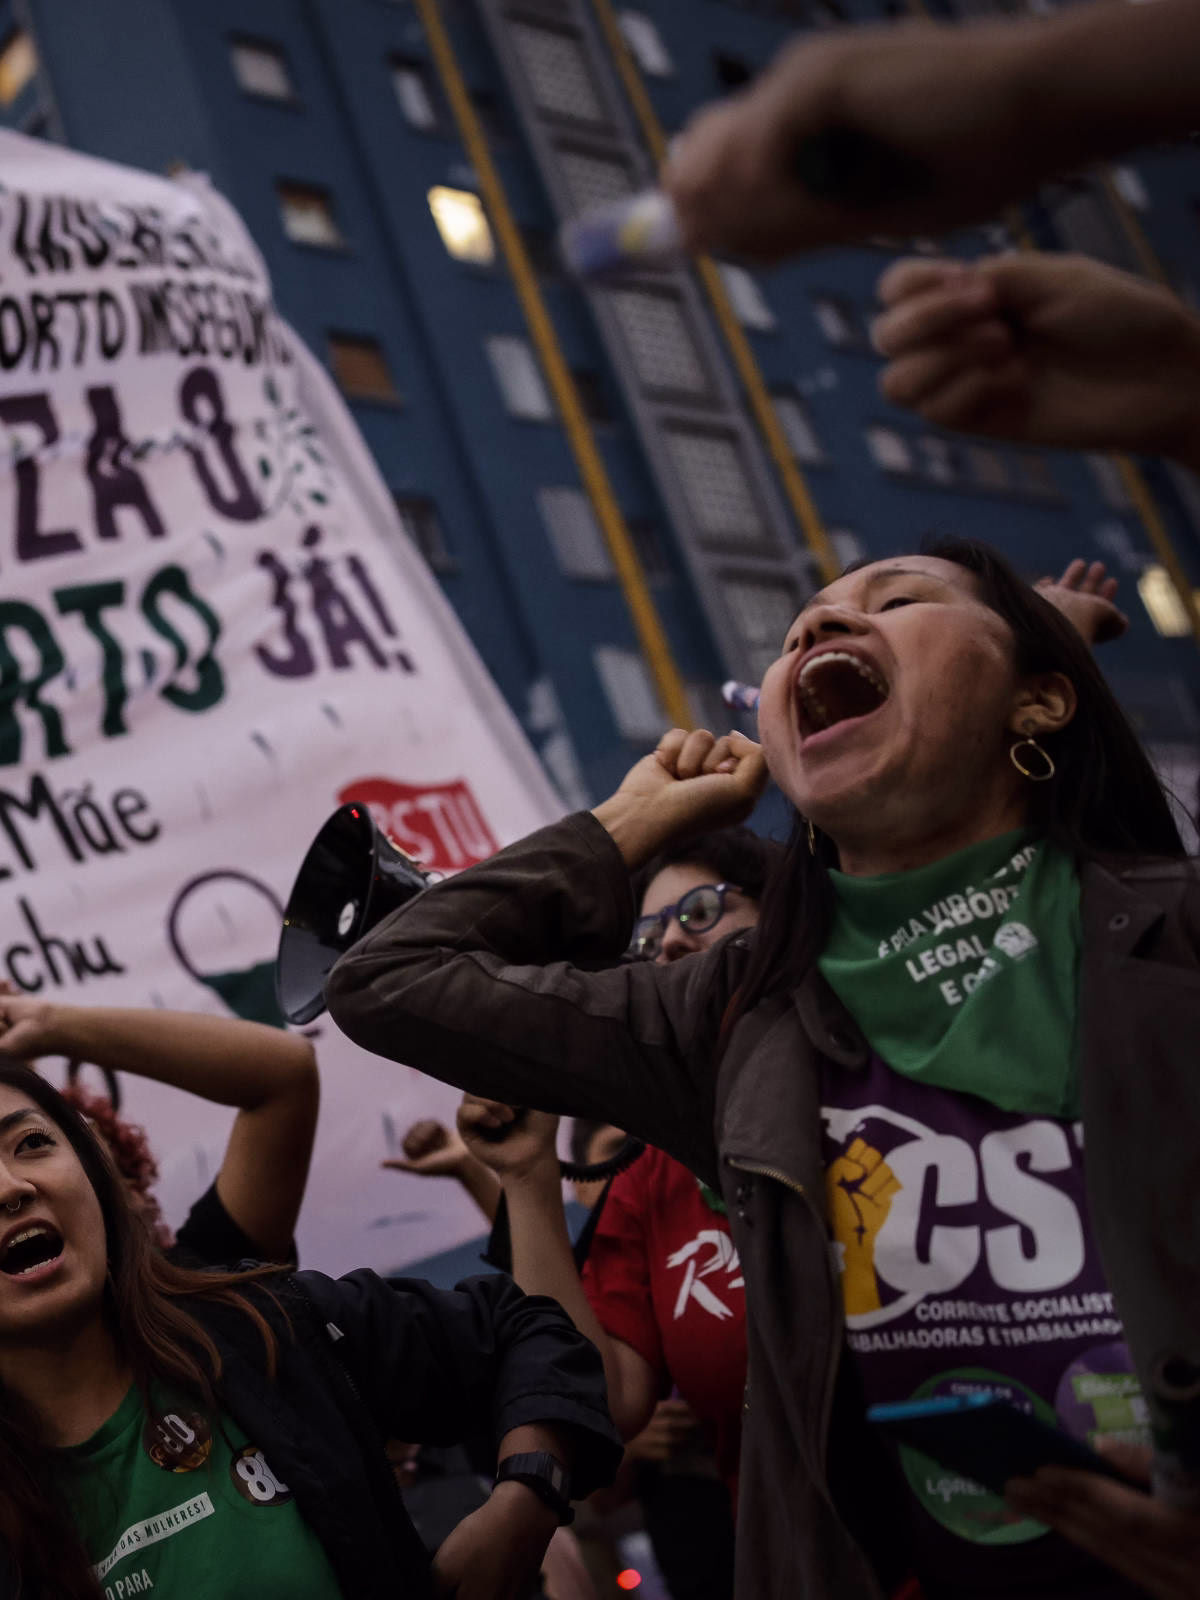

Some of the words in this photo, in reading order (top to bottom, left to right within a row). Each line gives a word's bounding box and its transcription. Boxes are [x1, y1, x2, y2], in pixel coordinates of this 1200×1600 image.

[253, 523, 416, 678] JÁ!
[874, 1120, 1085, 1295] CS
[120, 1530, 141, 1550] DAS
[144, 1501, 207, 1538] MULHERES!
[115, 1569, 154, 1600] PARA
